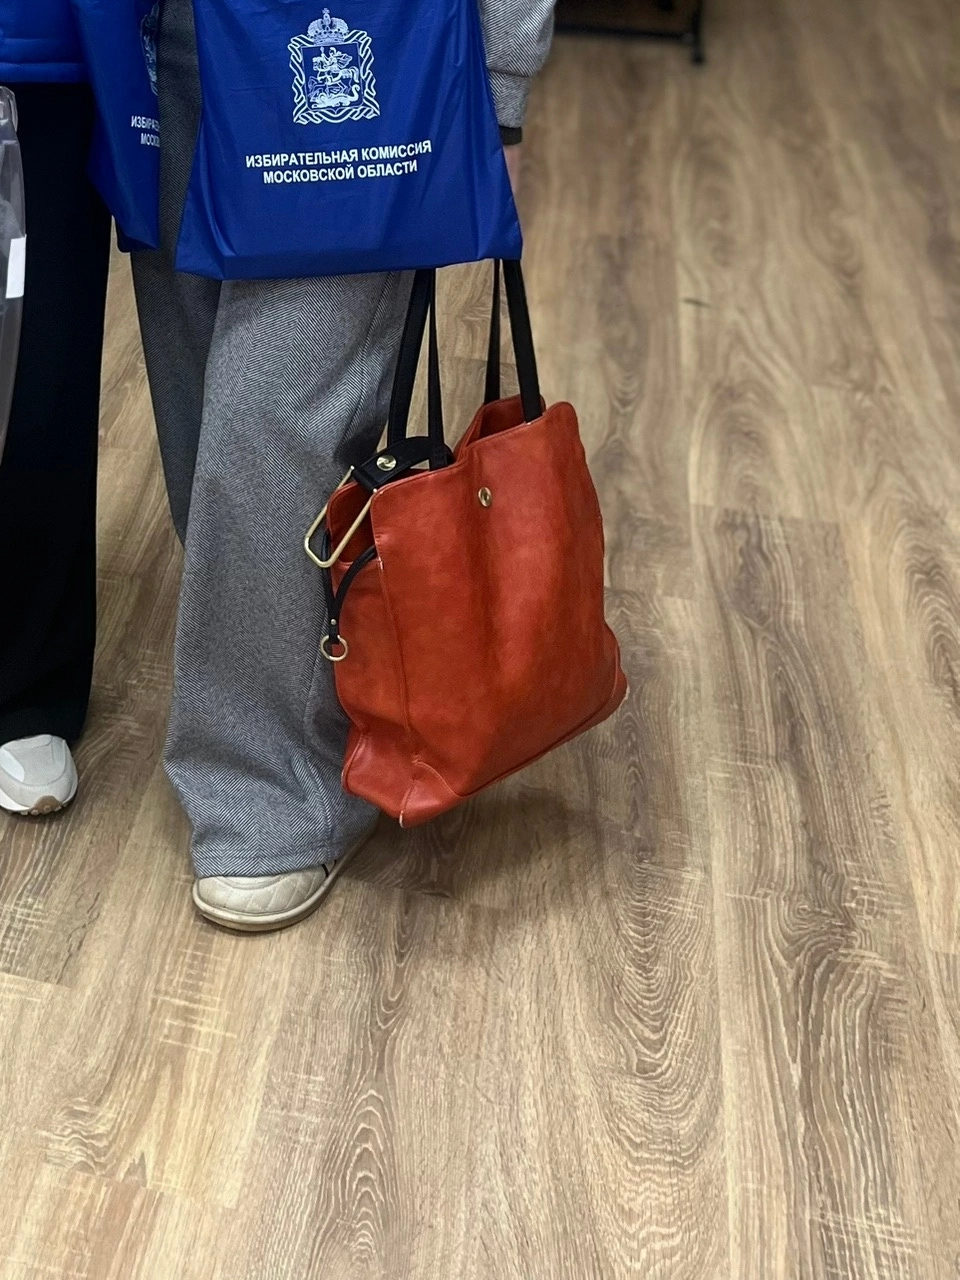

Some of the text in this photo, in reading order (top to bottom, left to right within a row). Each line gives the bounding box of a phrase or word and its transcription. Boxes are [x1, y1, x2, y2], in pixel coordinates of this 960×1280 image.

[245, 140, 432, 168] ИЗБИРАТЕЛЬНАЯ КОМИССИЯ
[263, 159, 418, 184] МОСКОВСКОЙ ОБЛАСТИ
